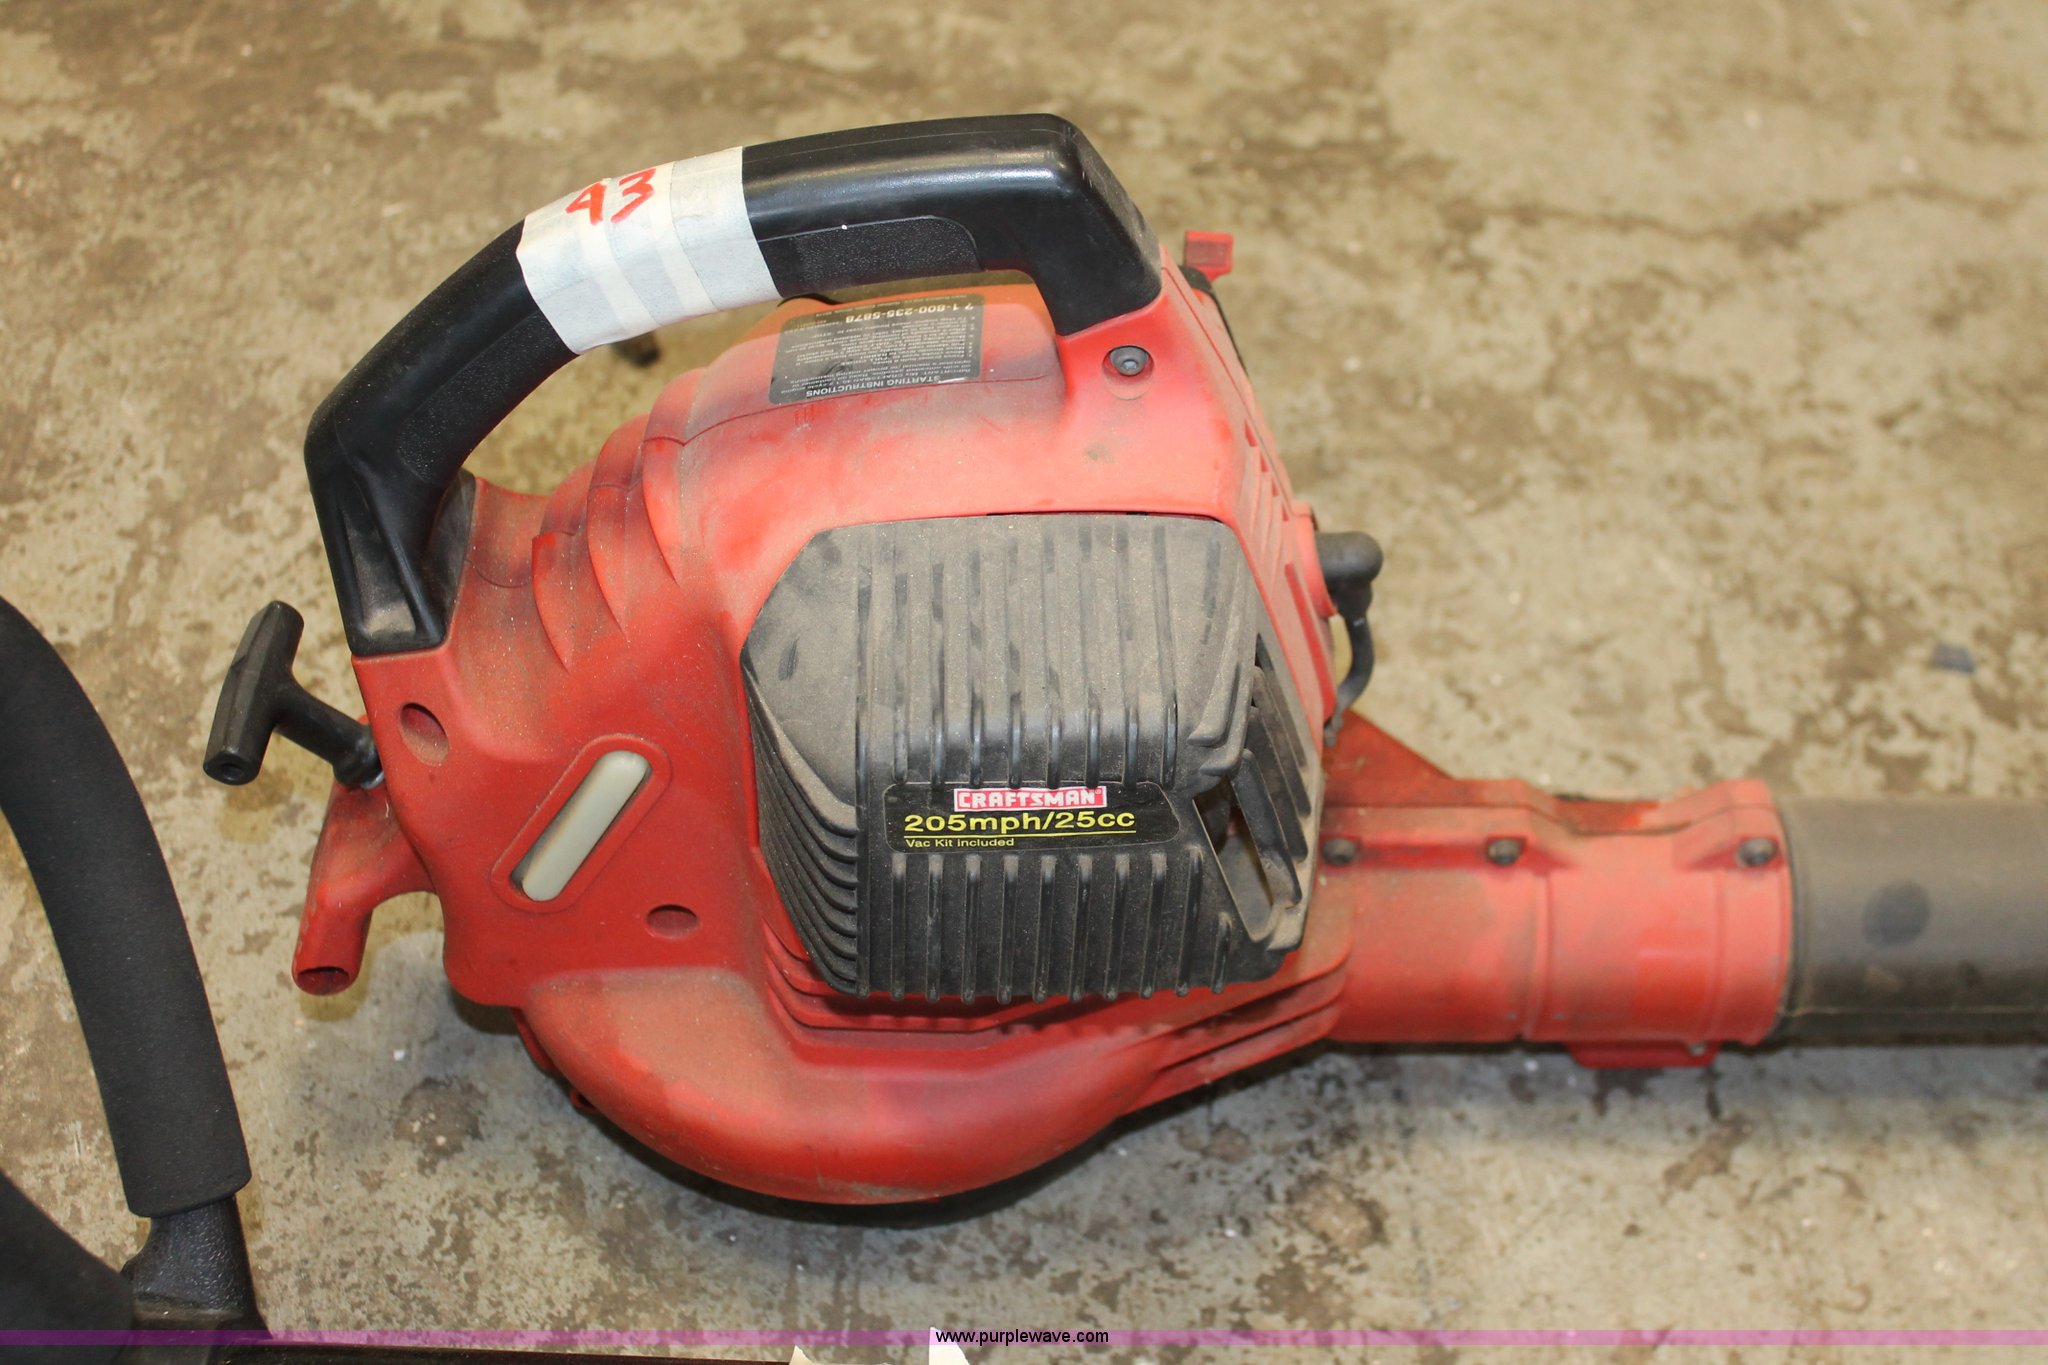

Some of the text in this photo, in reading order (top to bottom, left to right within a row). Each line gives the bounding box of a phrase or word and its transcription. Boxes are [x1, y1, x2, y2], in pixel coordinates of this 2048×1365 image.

[564, 168, 656, 225] 43
[845, 303, 959, 323] 1-800-235-5878
[806, 376, 940, 397] STARTING INSTRUCTIONS
[904, 810, 1136, 834] 205mph/25cc
[905, 836, 1014, 848] Vac Kit included
